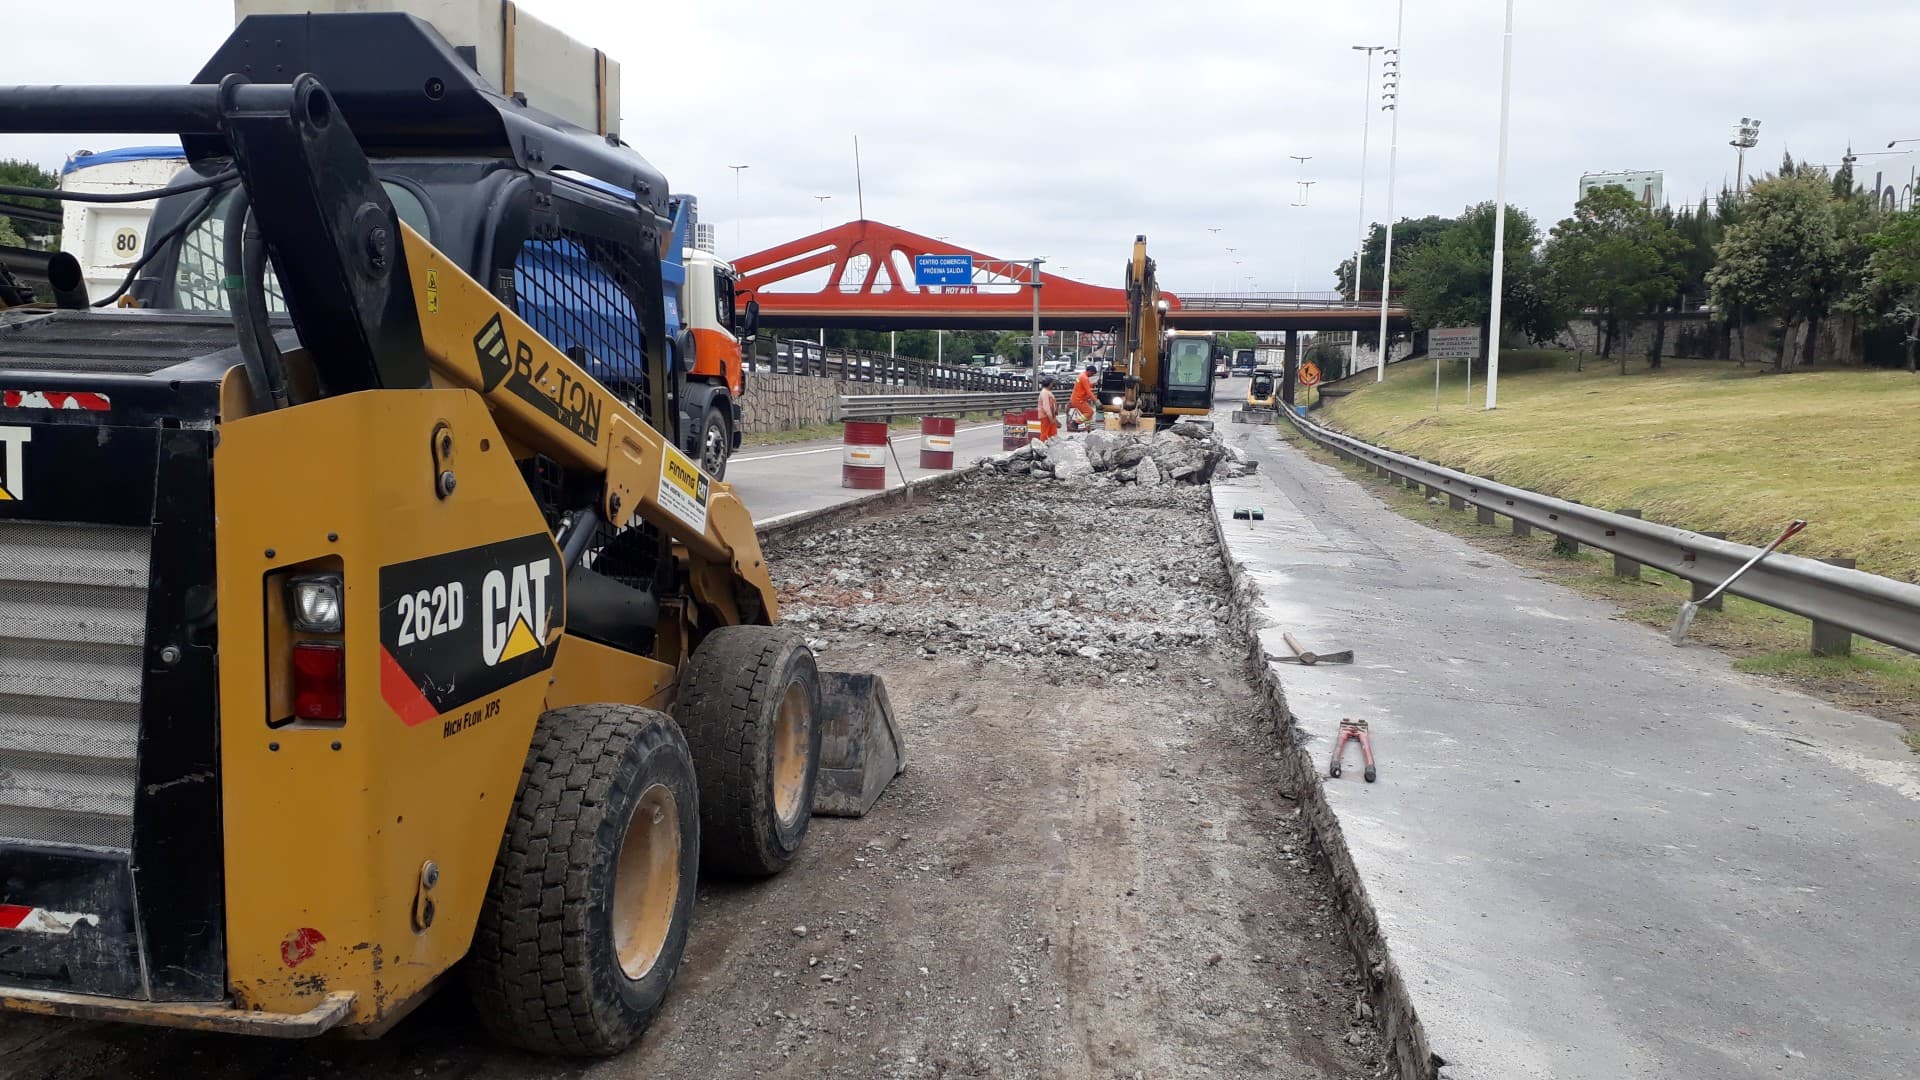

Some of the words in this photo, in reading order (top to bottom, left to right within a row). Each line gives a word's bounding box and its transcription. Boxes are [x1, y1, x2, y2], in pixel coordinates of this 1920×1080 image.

[117, 234, 136, 250] 80
[398, 581, 464, 647] 262D
[482, 558, 550, 667] CAT
[484, 699, 501, 721] XPS
